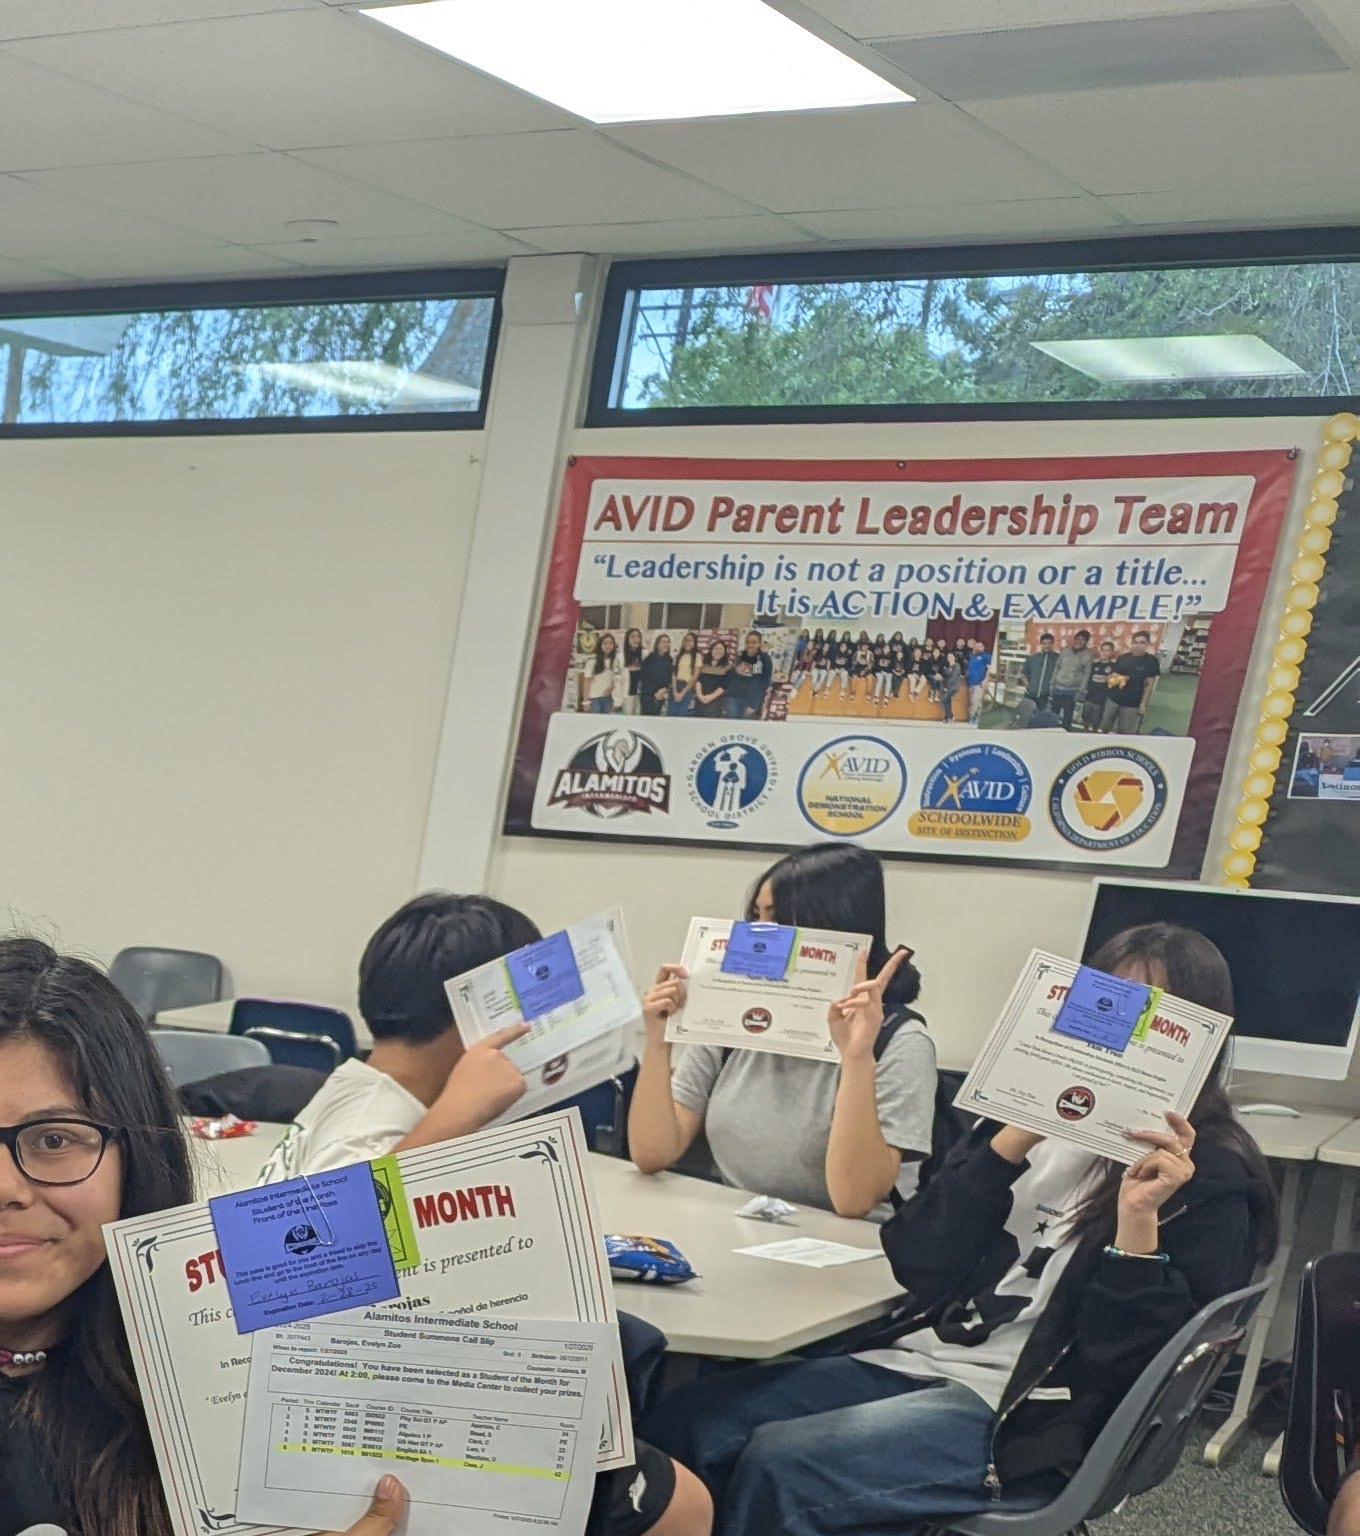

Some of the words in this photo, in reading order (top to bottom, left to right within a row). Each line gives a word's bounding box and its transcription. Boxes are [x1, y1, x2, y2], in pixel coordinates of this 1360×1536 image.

[594, 495, 695, 532] AVID
[707, 496, 845, 534] Parent
[856, 493, 1099, 544] Leadership
[1114, 495, 1238, 535] Team
[594, 554, 764, 586] “Leadership
[775, 555, 797, 581] is
[807, 558, 860, 582] not
[868, 562, 884, 583] a
[894, 557, 1026, 589] position
[1038, 565, 1076, 585] or
[1084, 566, 1102, 585] a
[1116, 557, 1207, 586] title...
[757, 589, 779, 614] It
[788, 590, 810, 615] is
[816, 591, 954, 616] ACTION
[965, 593, 994, 618] &
[1002, 593, 1201, 620] EXAMPLE!”
[840, 757, 890, 773] AVID
[555, 772, 667, 803] ALAMITOS
[960, 780, 1015, 800] AVID
[918, 811, 1022, 827] SCHOOLWIDE
[917, 827, 937, 835] SITE
[940, 827, 952, 835] OF
[955, 828, 1017, 839] DISTINCTION
[799, 944, 837, 964] MONTH
[1150, 1014, 1192, 1047] MONTH
[413, 1183, 517, 1231] MONTH
[188, 1307, 222, 1329] This
[423, 1259, 437, 1275] is
[438, 1238, 512, 1273] presented
[515, 1237, 536, 1253] to
[263, 1304, 298, 1316] Expiration
[363, 1311, 412, 1324] Alamitos
[413, 1314, 480, 1329] Intermediate
[482, 1319, 519, 1332] School
[361, 1339, 386, 1349] Evelyn
[386, 1341, 402, 1349] Zoe
[383, 1329, 417, 1339] Student
[418, 1332, 461, 1343] Summons
[462, 1335, 479, 1345] Call
[479, 1337, 496, 1347] Slip
[271, 1364, 313, 1375] December
[314, 1367, 338, 1377] 2024!
[338, 1369, 349, 1378] At
[350, 1370, 371, 1381] 2:00,
[371, 1373, 401, 1382] please
[401, 1376, 425, 1384] come
[426, 1377, 435, 1385] to
[436, 1378, 450, 1386] the
[451, 1379, 475, 1389] Media
[476, 1381, 503, 1391] Center
[503, 1384, 512, 1392] to
[512, 1385, 539, 1394] collect
[539, 1388, 558, 1396] your
[558, 1389, 583, 1398] prizes.
[288, 1354, 358, 1369] Congratulations!
[361, 1362, 380, 1371] You
[380, 1363, 402, 1373] have
[402, 1365, 424, 1375] been
[425, 1368, 460, 1378] selected
[479, 1370, 510, 1382] Student
[510, 1375, 520, 1383] of
[519, 1376, 533, 1384] the
[533, 1376, 558, 1386] Month
[558, 1376, 571, 1387] for
